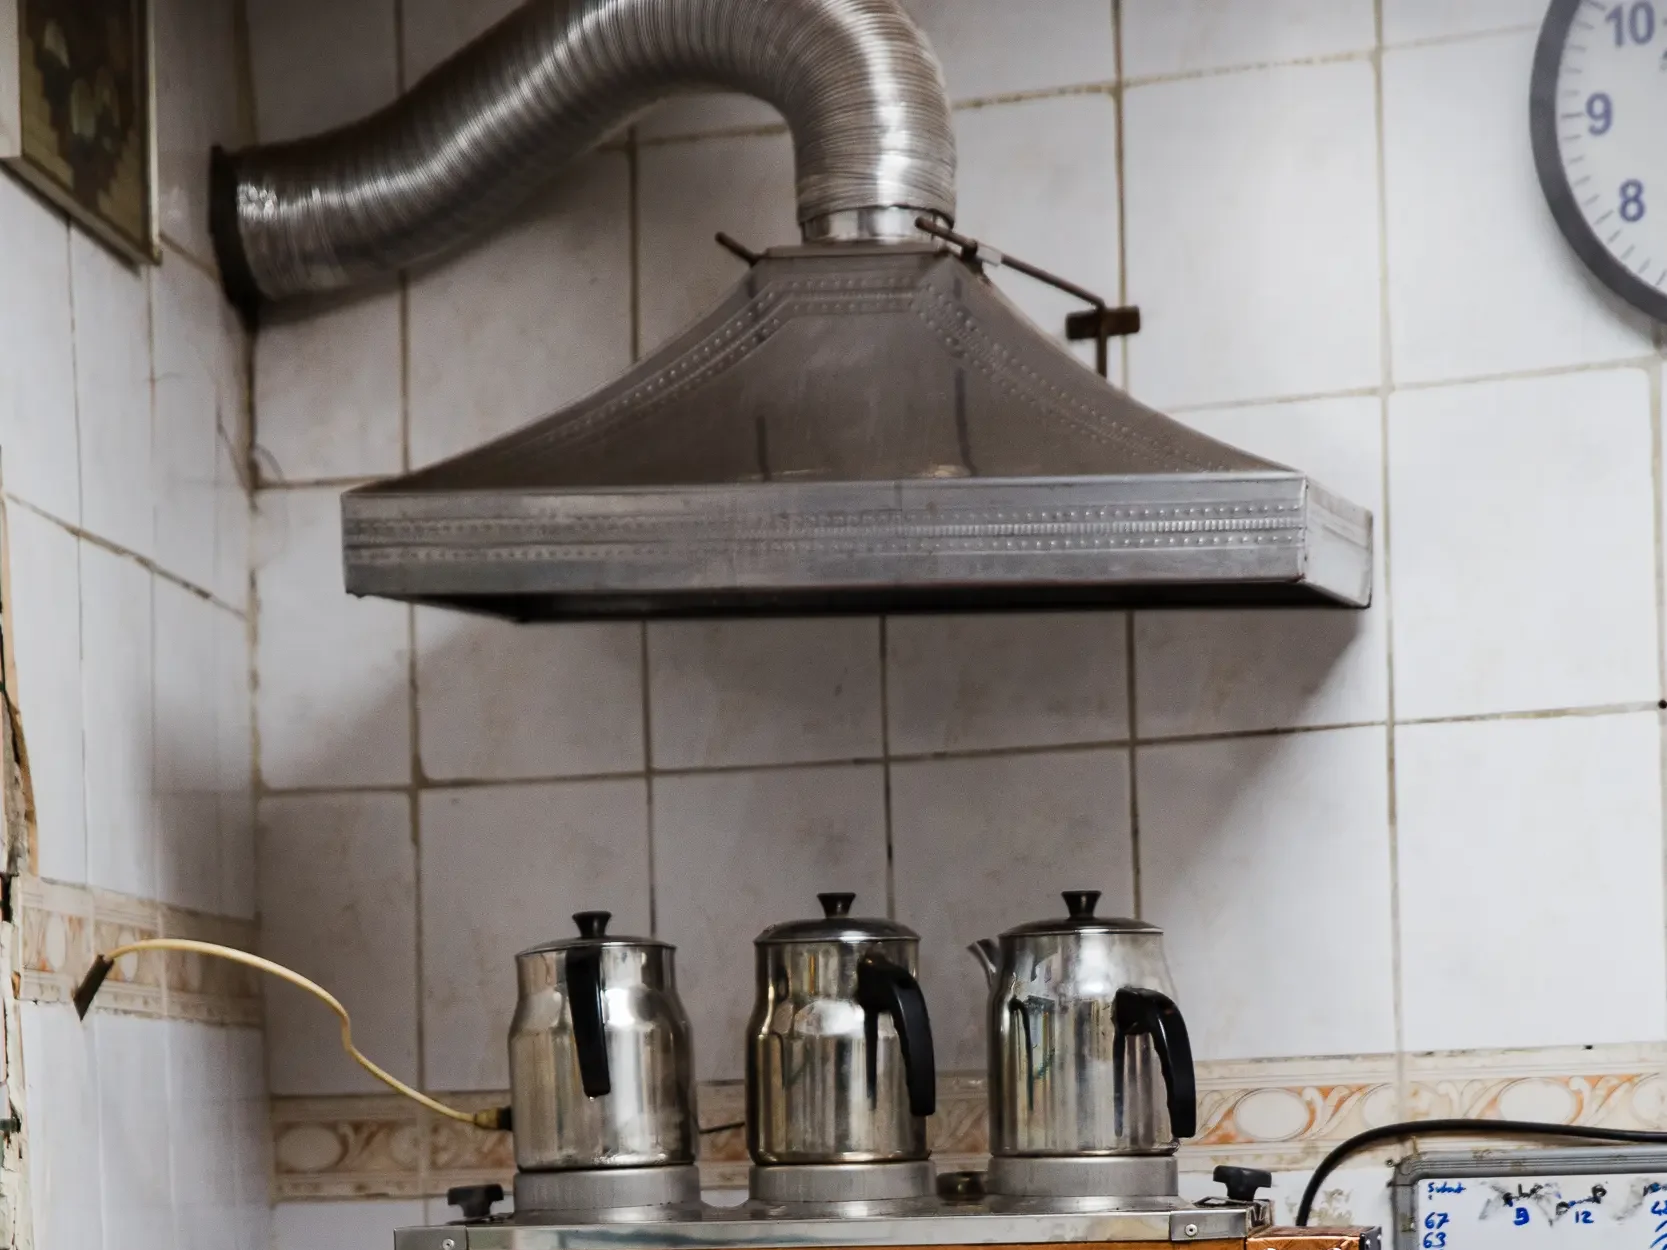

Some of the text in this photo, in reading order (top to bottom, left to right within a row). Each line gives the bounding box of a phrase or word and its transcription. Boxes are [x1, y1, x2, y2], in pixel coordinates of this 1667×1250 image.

[1604, 1, 1656, 48] 10
[1585, 92, 1613, 136] 9
[1618, 179, 1646, 223] 8
[1424, 1211, 1450, 1230] 67
[1574, 1210, 1595, 1224] 12
[1423, 1232, 1447, 1249] 63
